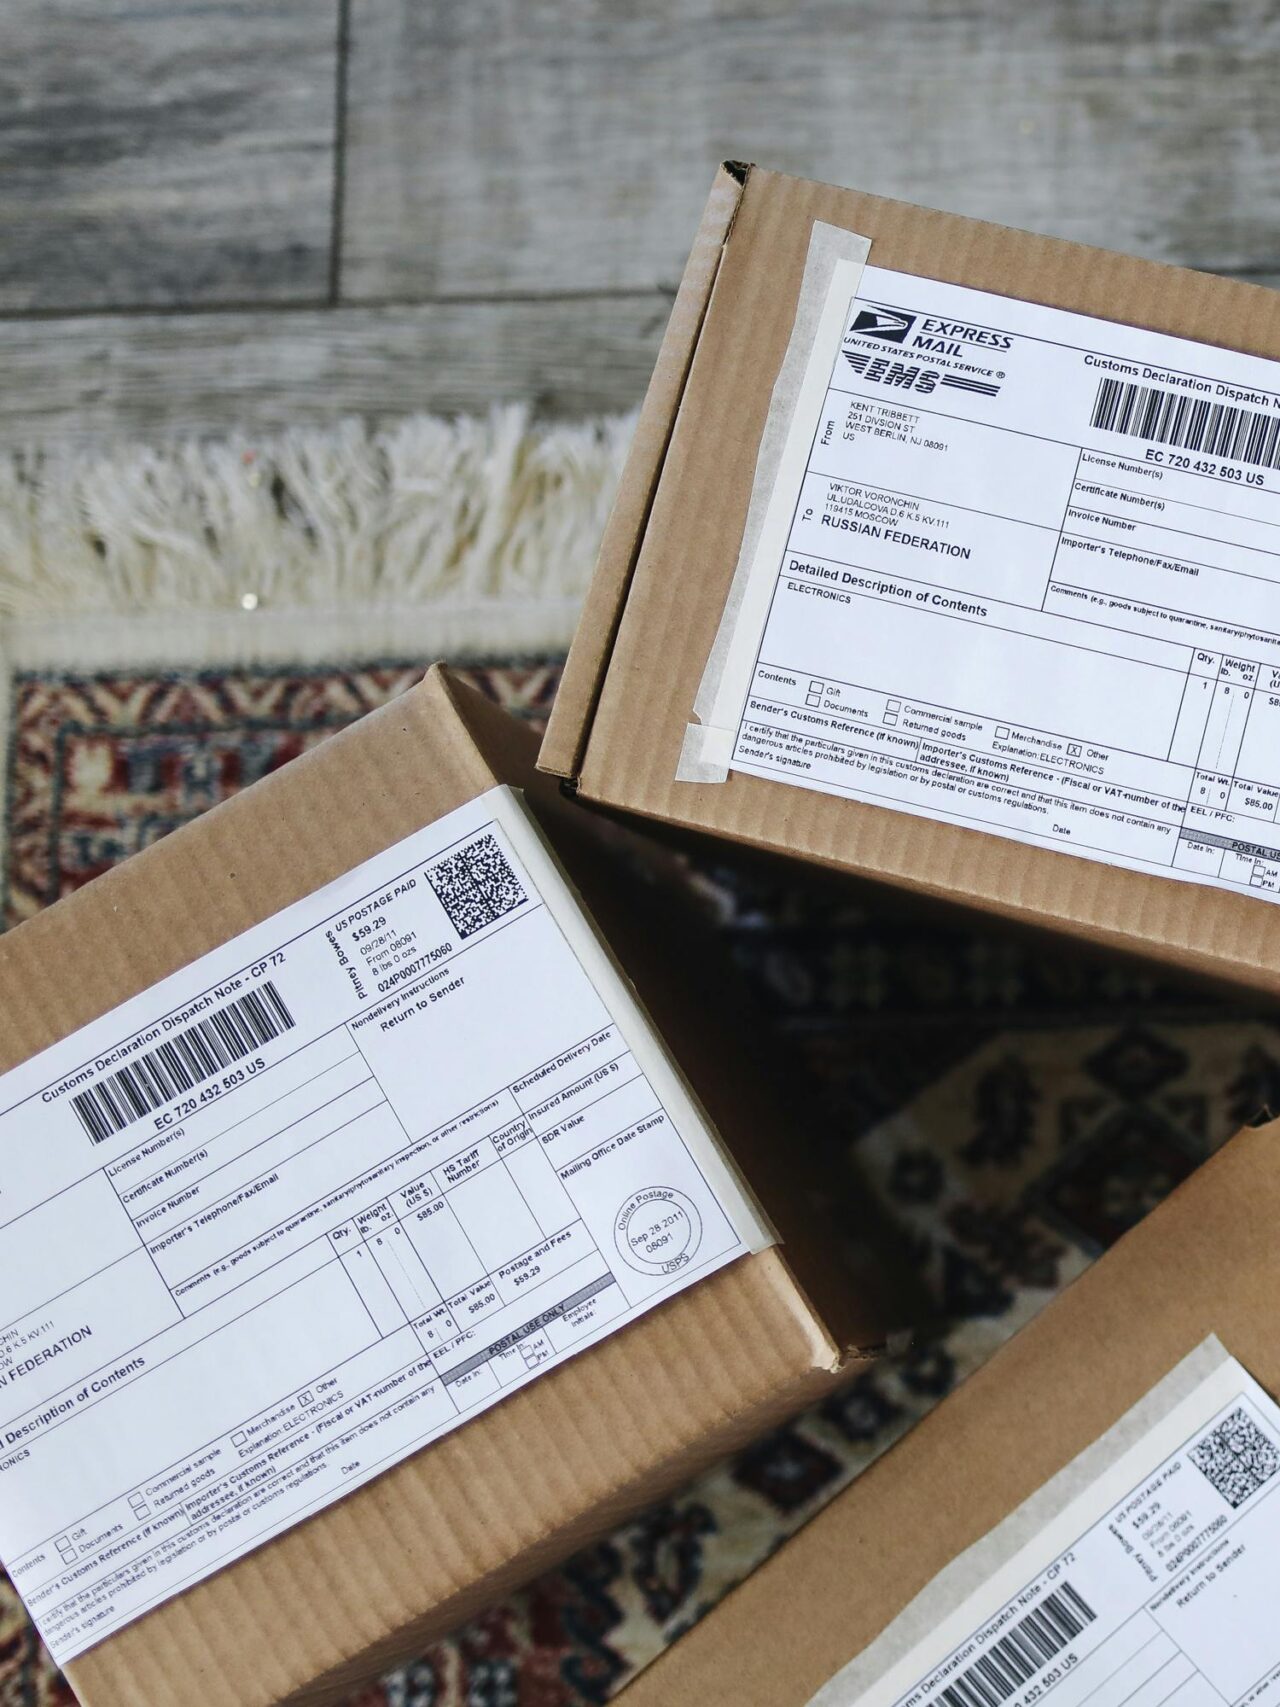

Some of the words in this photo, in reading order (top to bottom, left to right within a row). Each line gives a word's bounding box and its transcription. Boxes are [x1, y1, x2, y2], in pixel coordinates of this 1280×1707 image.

[911, 335, 963, 358] MAIL
[921, 318, 1014, 349] EXPRESS
[843, 336, 881, 350] UNITED
[880, 345, 916, 359] STATES
[915, 353, 951, 368] POSTAL
[952, 362, 994, 377] SERVICE
[867, 357, 939, 393] EMS
[1083, 354, 1139, 376] Customs
[1142, 367, 1212, 393] Declaration
[1215, 384, 1270, 407] Dispatch
[847, 410, 863, 422] 251
[902, 424, 916, 434] ST
[850, 401, 875, 413] KENT
[876, 406, 920, 424] TRIBBETT
[820, 420, 835, 446] From
[842, 431, 856, 442] US
[845, 420, 873, 434] WEST
[909, 436, 923, 446] NJ
[923, 439, 948, 451] 08091
[1081, 453, 1117, 468] License
[1117, 461, 1164, 481] Number(s)
[1145, 448, 1164, 463] EC
[1168, 453, 1191, 469] 720
[1192, 460, 1217, 475] 432
[1219, 465, 1243, 481] 503
[1245, 471, 1265, 486] US
[829, 482, 863, 498] VIKTOR
[864, 490, 920, 511] VORONCHIN
[1074, 482, 1119, 500] Certificate
[1119, 492, 1165, 512] Number(s)
[801, 508, 814, 522] To
[825, 503, 854, 516] 119415
[854, 509, 899, 527] MOSCOW
[1068, 508, 1101, 523] Invoice
[1101, 516, 1137, 532] Number
[821, 514, 882, 538] RUSSIAN
[883, 528, 972, 560] FEDERATION
[1060, 536, 1106, 555] Importer's
[787, 581, 852, 604] ELECTRONICS
[789, 559, 840, 581] Detailed
[841, 572, 913, 599] Description
[915, 592, 931, 603] of
[931, 594, 988, 617] Contents
[1225, 658, 1256, 673] Weight
[335, 919, 349, 932] US
[347, 891, 394, 925] POSTAGE
[393, 878, 417, 898] PAID
[351, 916, 387, 942] $59.29
[359, 929, 397, 956] 09/28/11
[325, 930, 349, 967] Bowes
[365, 949, 390, 967] From
[389, 931, 417, 952] 08091
[345, 966, 368, 1000] Pitney
[377, 942, 453, 993] 024P0007775060
[379, 1007, 416, 1033] Return
[415, 1000, 428, 1011] to
[428, 976, 465, 1003] Sender
[41, 1068, 95, 1103] Customs
[94, 1028, 161, 1072] Declaration
[161, 996, 214, 1032] Dispatch
[213, 979, 243, 1000] Note
[250, 961, 268, 978] CP
[268, 952, 286, 967] 72
[512, 1062, 557, 1094] Scheduled
[556, 1043, 591, 1068] Delivery
[590, 1031, 611, 1047] Date
[153, 1112, 173, 1131] EC
[173, 1097, 198, 1118] 720
[199, 1083, 222, 1103] 432
[222, 1069, 245, 1089] 503
[245, 1057, 266, 1075] US
[541, 1128, 561, 1144] SDR
[560, 1115, 585, 1132] Value
[107, 1154, 142, 1178] License
[141, 1127, 185, 1158] Number(s)
[135, 1206, 167, 1229] Invoice
[166, 1186, 200, 1210] Number
[416, 1200, 445, 1222] $85.00
[149, 1225, 193, 1255] Importer's
[626, 1233, 649, 1248] Sep
[648, 1223, 662, 1236] 28
[661, 1206, 688, 1228] 2011
[645, 1232, 674, 1254] 08091
[7, 1325, 93, 1382] FEDERATION
[4, 1399, 75, 1445] Description
[76, 1387, 90, 1402] of
[90, 1357, 146, 1393] Contents
